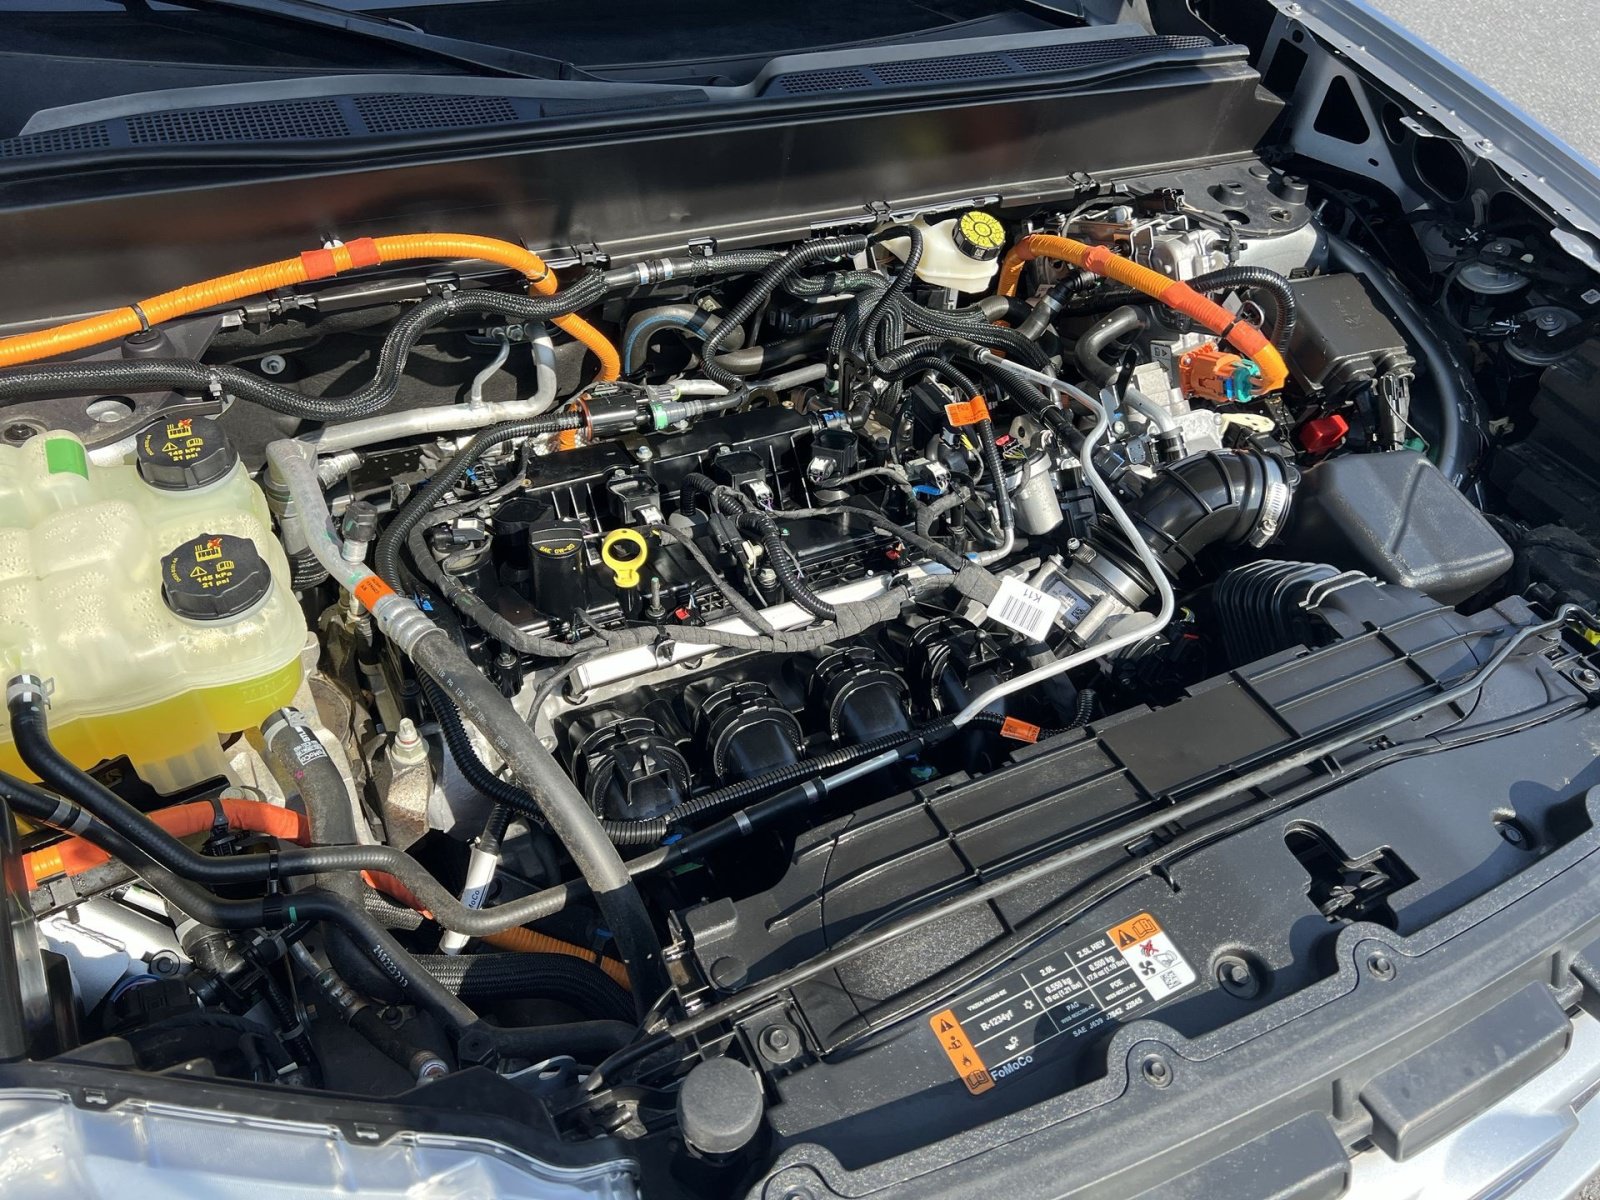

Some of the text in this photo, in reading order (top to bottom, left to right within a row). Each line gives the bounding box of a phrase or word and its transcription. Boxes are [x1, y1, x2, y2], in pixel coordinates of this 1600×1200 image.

[185, 446, 201, 454] kPa
[172, 452, 198, 462] 21 psi
[215, 571, 232, 580] kPa
[202, 578, 230, 589] 21 psi
[1076, 939, 1106, 959] 2.5L HEV
[1104, 955, 1116, 964] kg
[1039, 965, 1056, 977] 2.0L
[1061, 977, 1073, 986] kg
[1065, 1001, 1080, 1012] PAG
[980, 1009, 1014, 1032] R-1234yf
[1072, 1025, 1088, 1038] SAE
[990, 1055, 1033, 1081] FoMoCo
